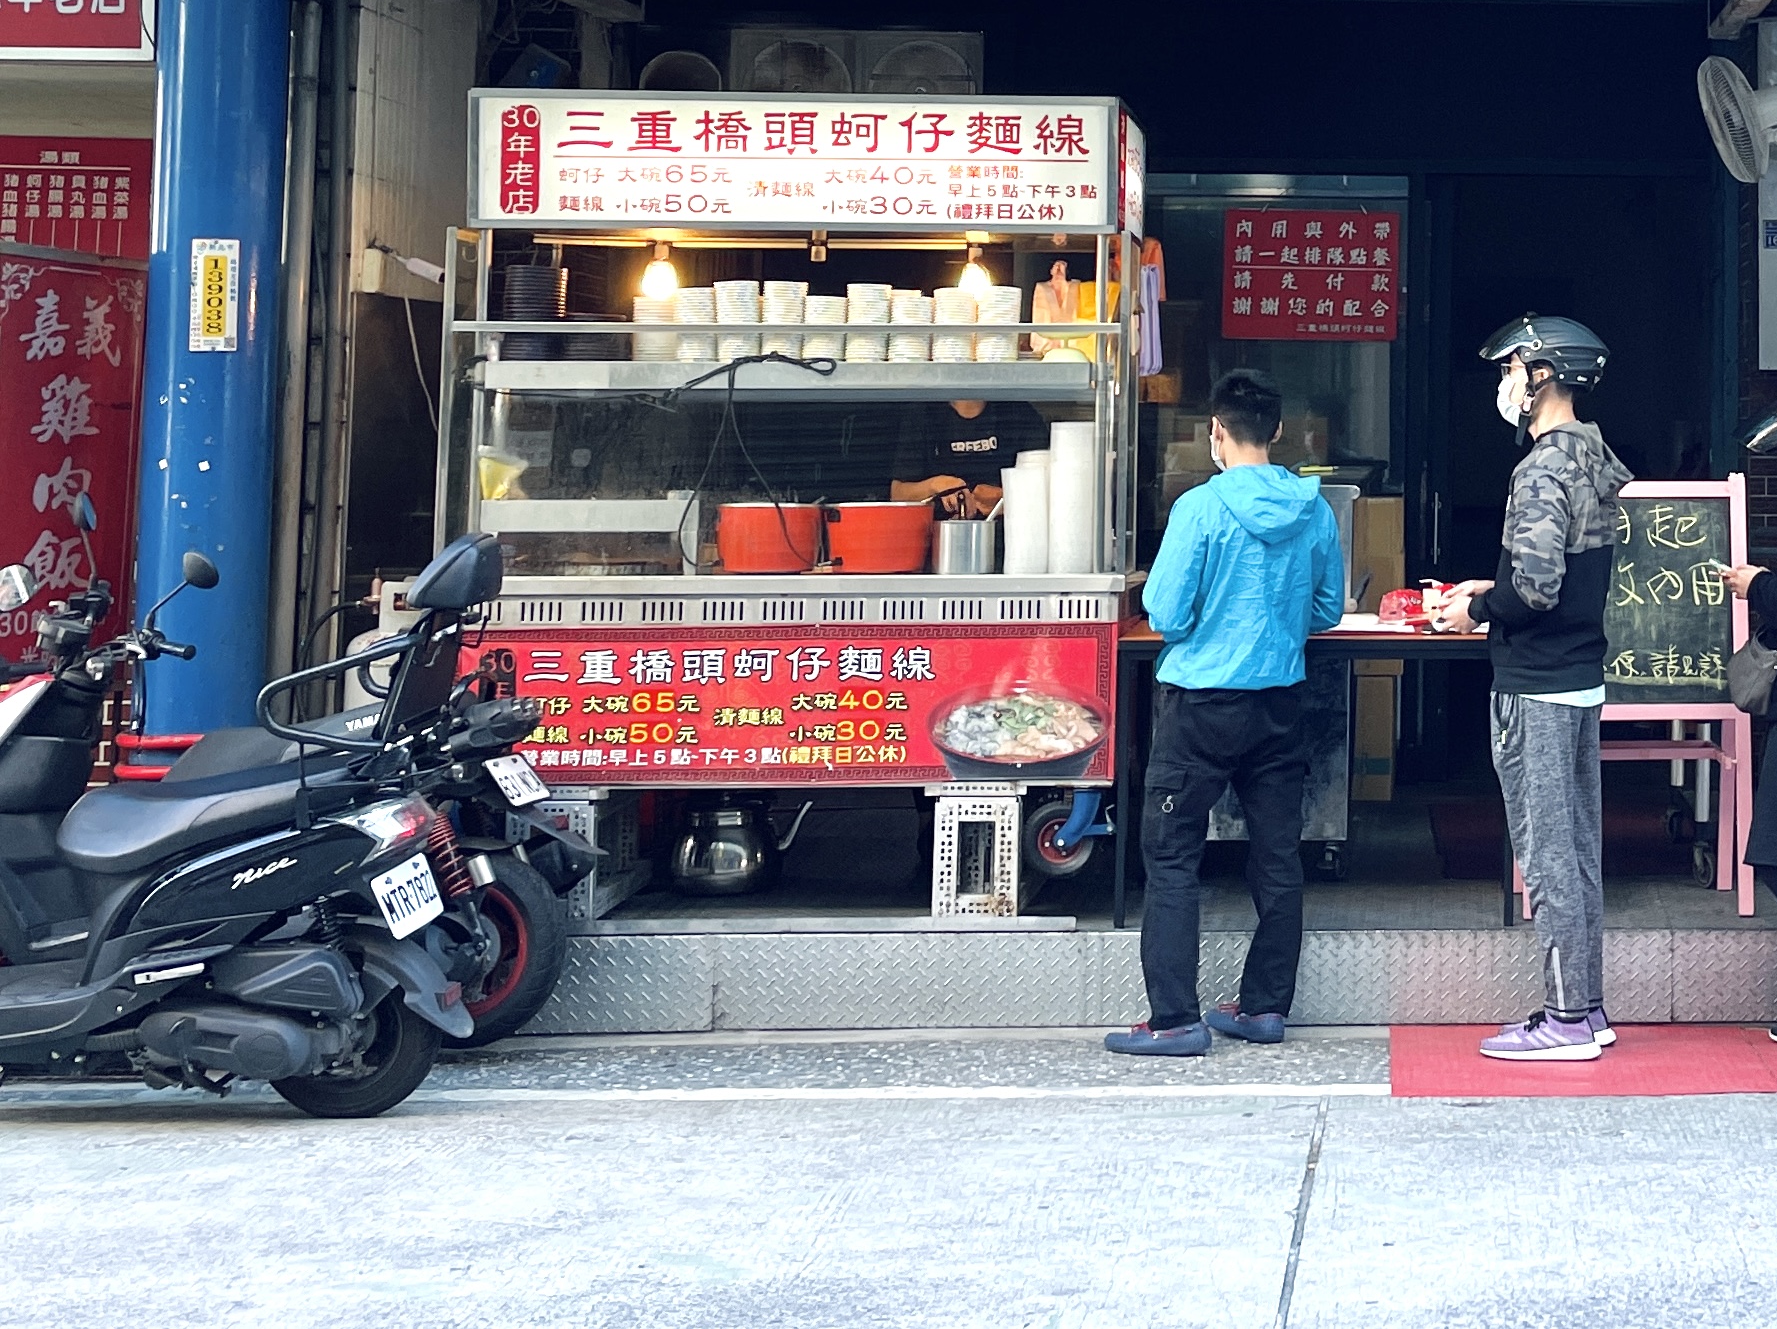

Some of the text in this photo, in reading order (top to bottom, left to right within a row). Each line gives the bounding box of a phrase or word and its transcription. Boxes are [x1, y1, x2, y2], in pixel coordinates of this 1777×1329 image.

[557, 110, 1090, 155] 三重橋頭蚵仔麵線
[502, 107, 539, 215] 30年老店
[558, 164, 733, 184] 蚵仔 大碗65元
[825, 165, 937, 186] 大碗40元
[558, 193, 732, 214] 麵線 小碗50元
[823, 196, 937, 217] 小碗30元
[947, 203, 1064, 220] (禮拜日公休)
[1235, 245, 1391, 267] 請一起排隊點餐
[1233, 272, 1390, 292] 請先付款
[206, 258, 223, 334] 139038
[1232, 296, 1390, 317] 謝謝您的配合
[19, 289, 121, 367] 嘉義
[24, 373, 100, 590] 雞肉飯
[524, 646, 935, 684] 三重橋頭蚵仔麵線
[582, 692, 700, 714] 大碗65元
[791, 689, 908, 711] 大碗40元
[714, 707, 784, 727] 清麵線
[580, 723, 698, 745] 小碗50元
[789, 720, 907, 742] 小碗30元
